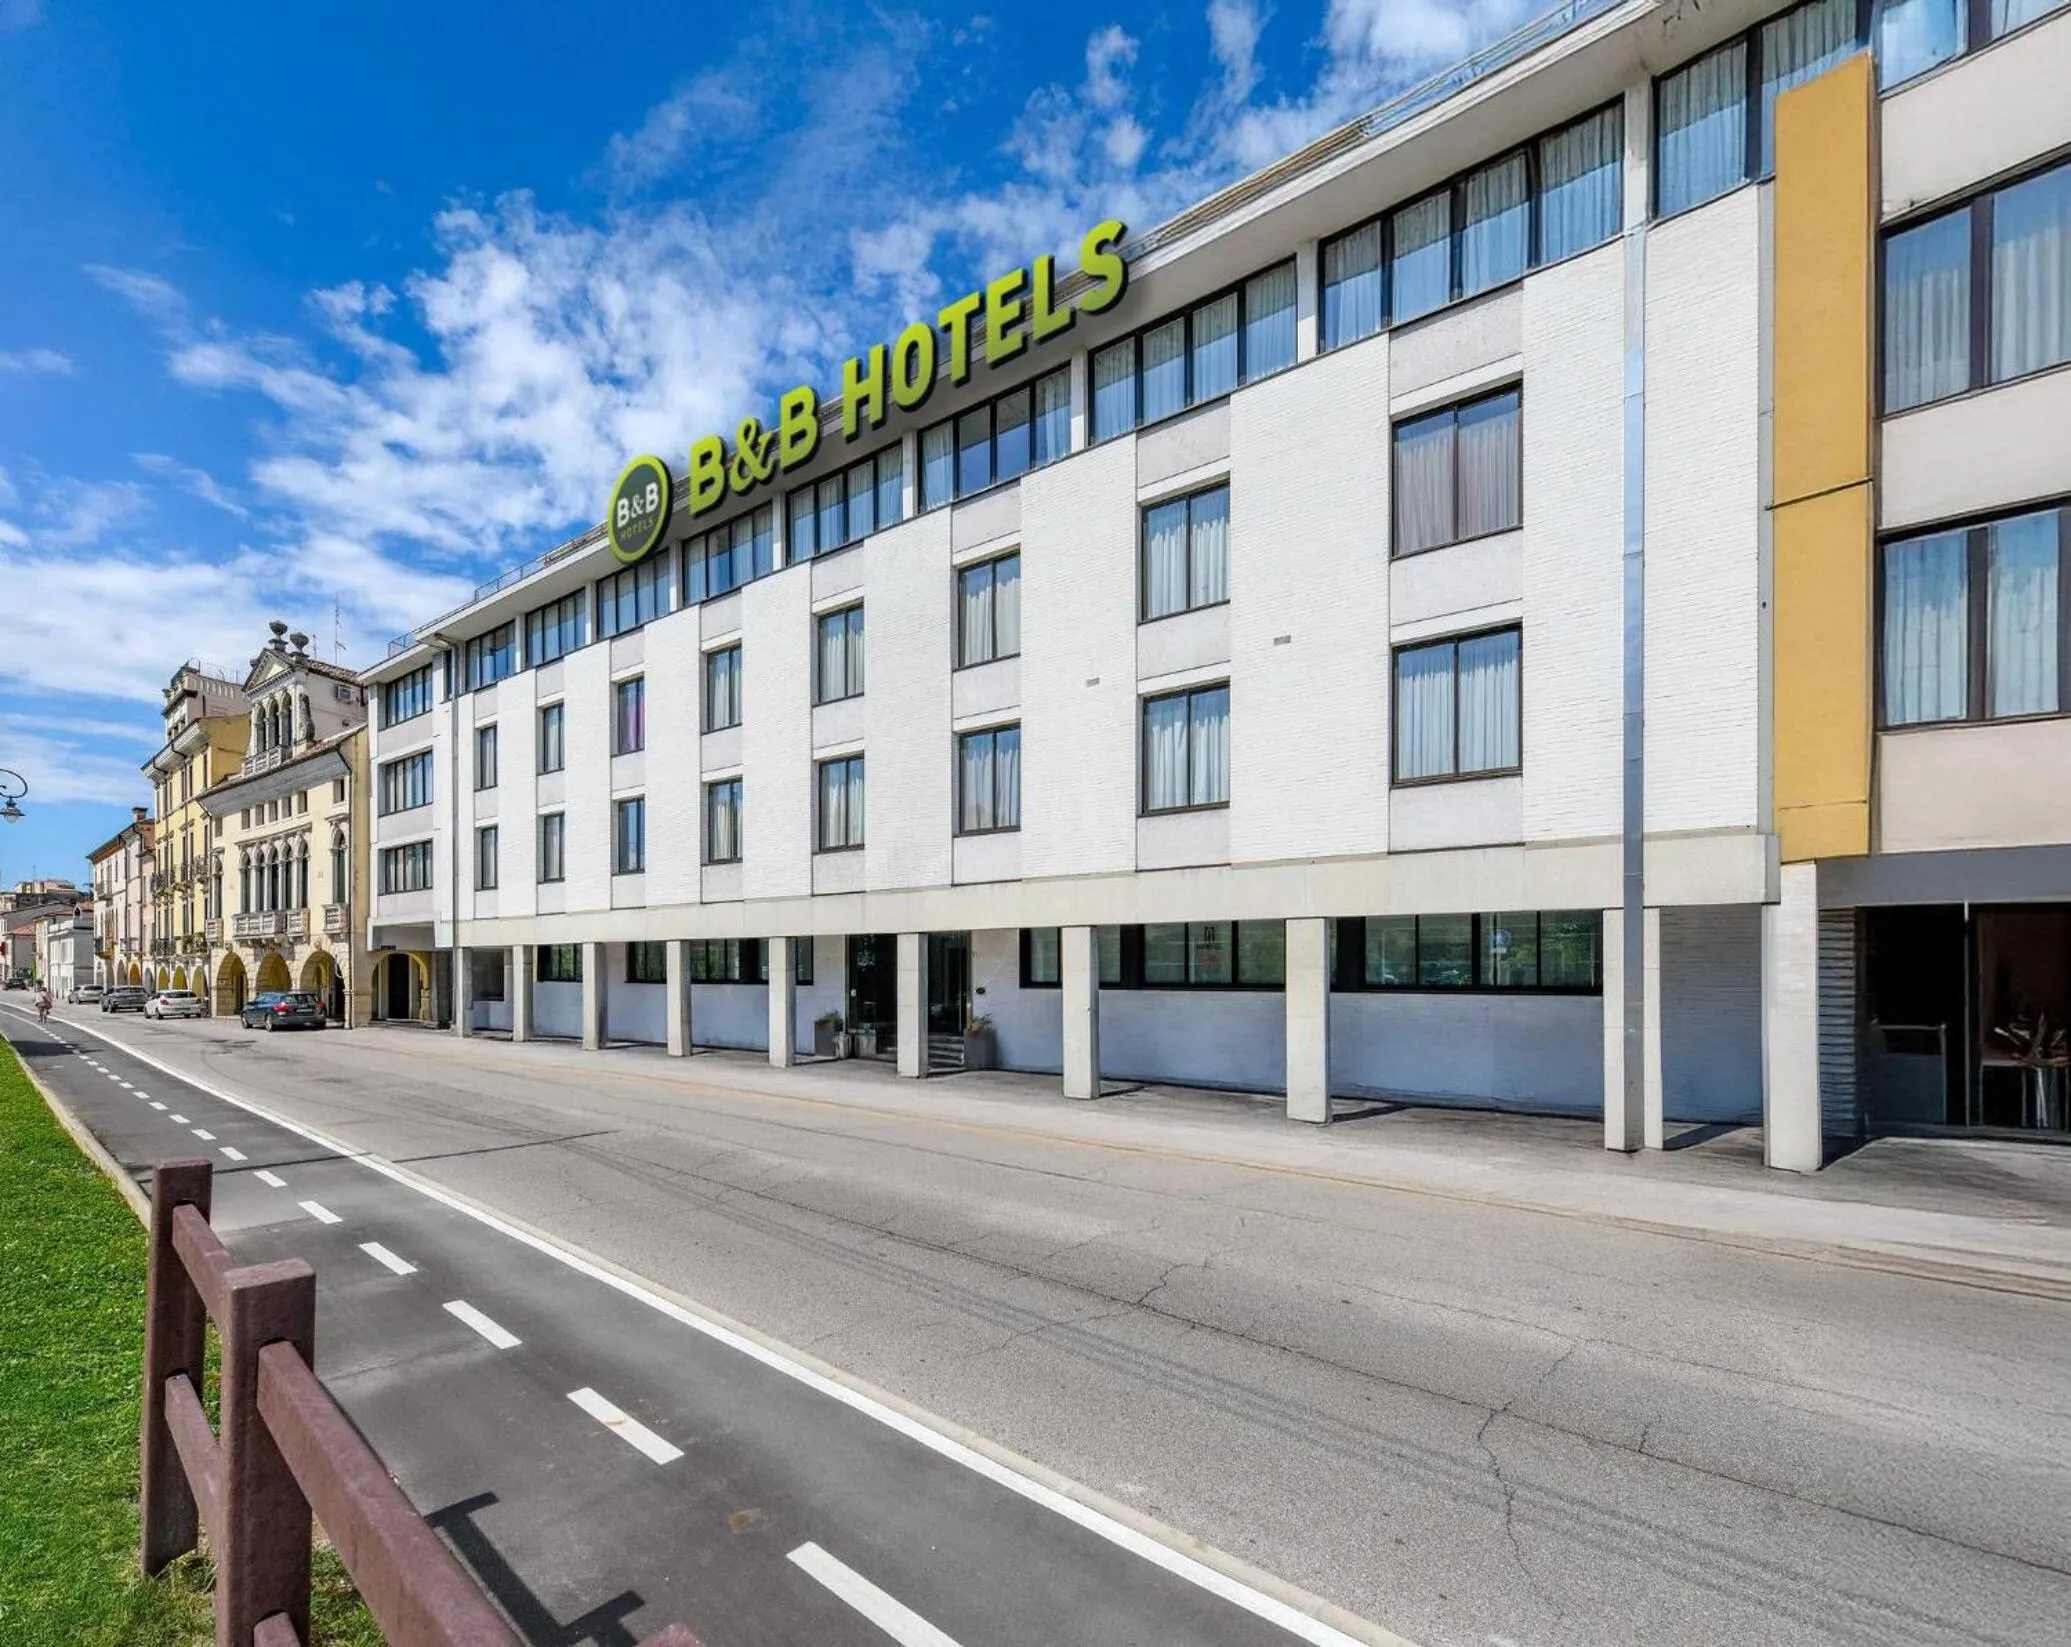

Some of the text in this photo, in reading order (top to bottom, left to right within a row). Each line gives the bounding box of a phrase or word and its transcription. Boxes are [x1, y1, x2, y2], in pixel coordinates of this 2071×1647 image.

[689, 219, 1128, 517] B&B HOTELS
[617, 481, 659, 528] B&B
[621, 515, 655, 540] HOTELS
